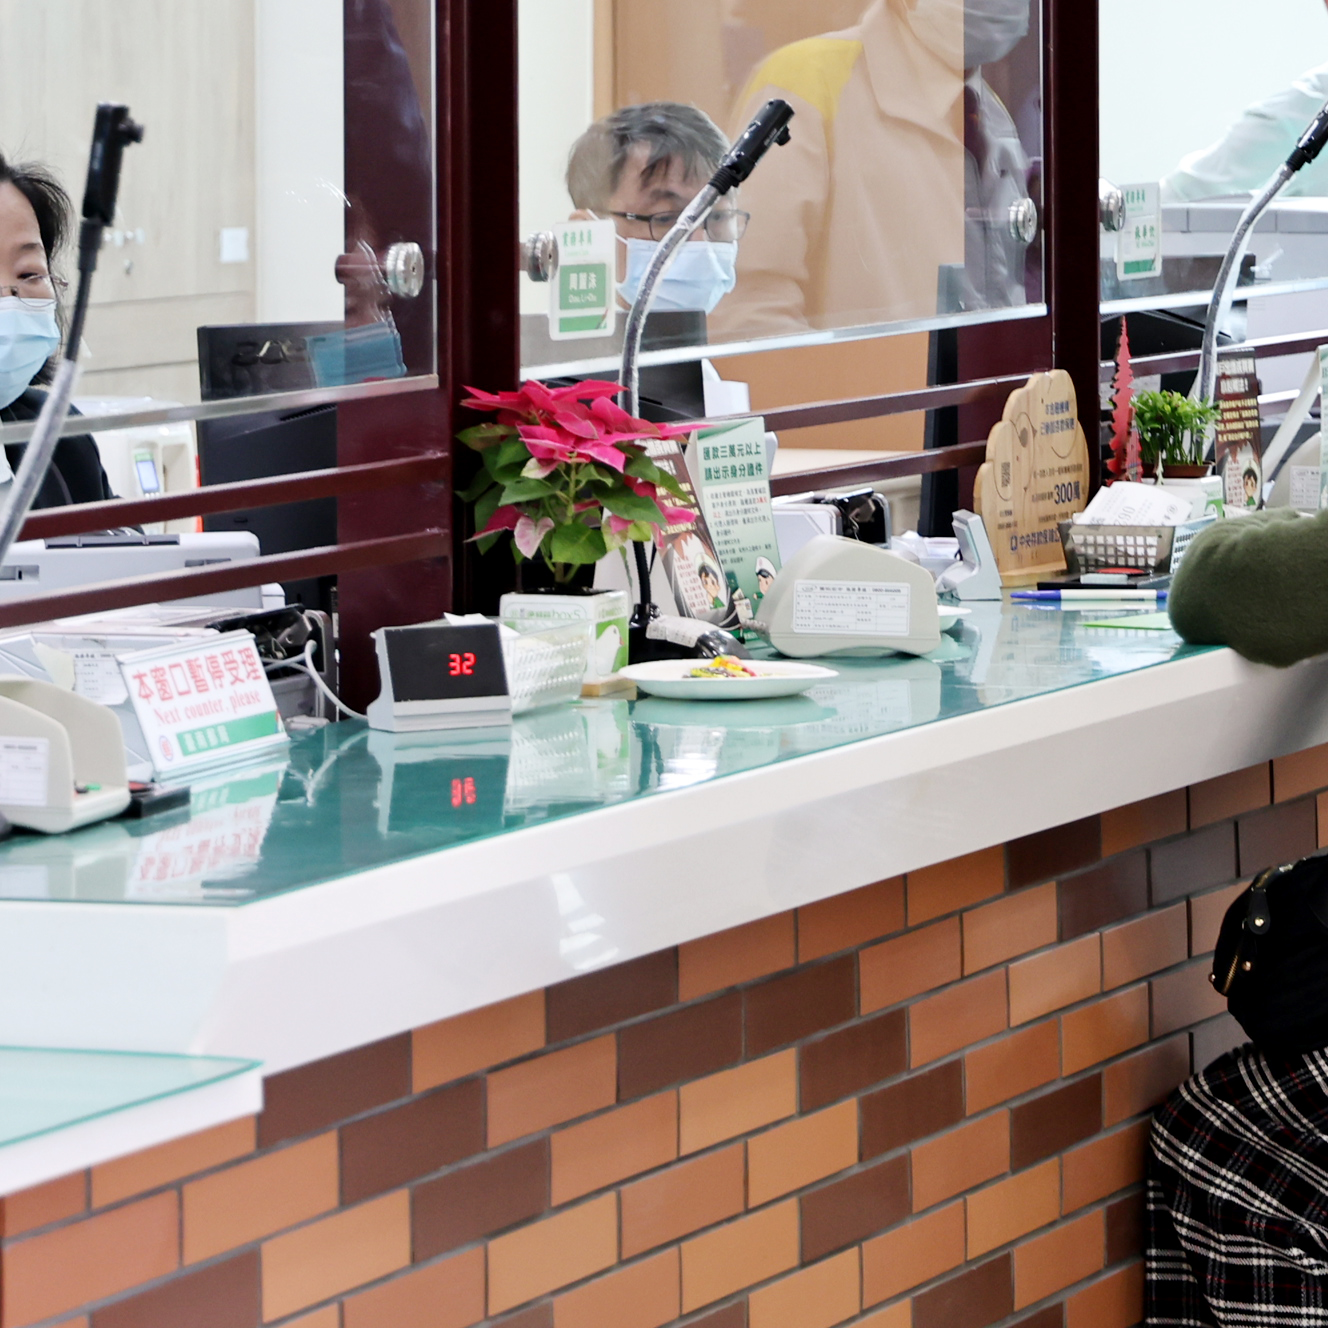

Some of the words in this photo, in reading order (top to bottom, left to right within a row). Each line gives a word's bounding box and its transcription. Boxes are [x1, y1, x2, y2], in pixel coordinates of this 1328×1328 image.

[703, 442, 762, 461] 匯款三萬元以上
[132, 647, 262, 705] 本窗口暫停受理
[448, 652, 477, 676] 32
[153, 707, 182, 727] Next
[229, 689, 262, 715] please
